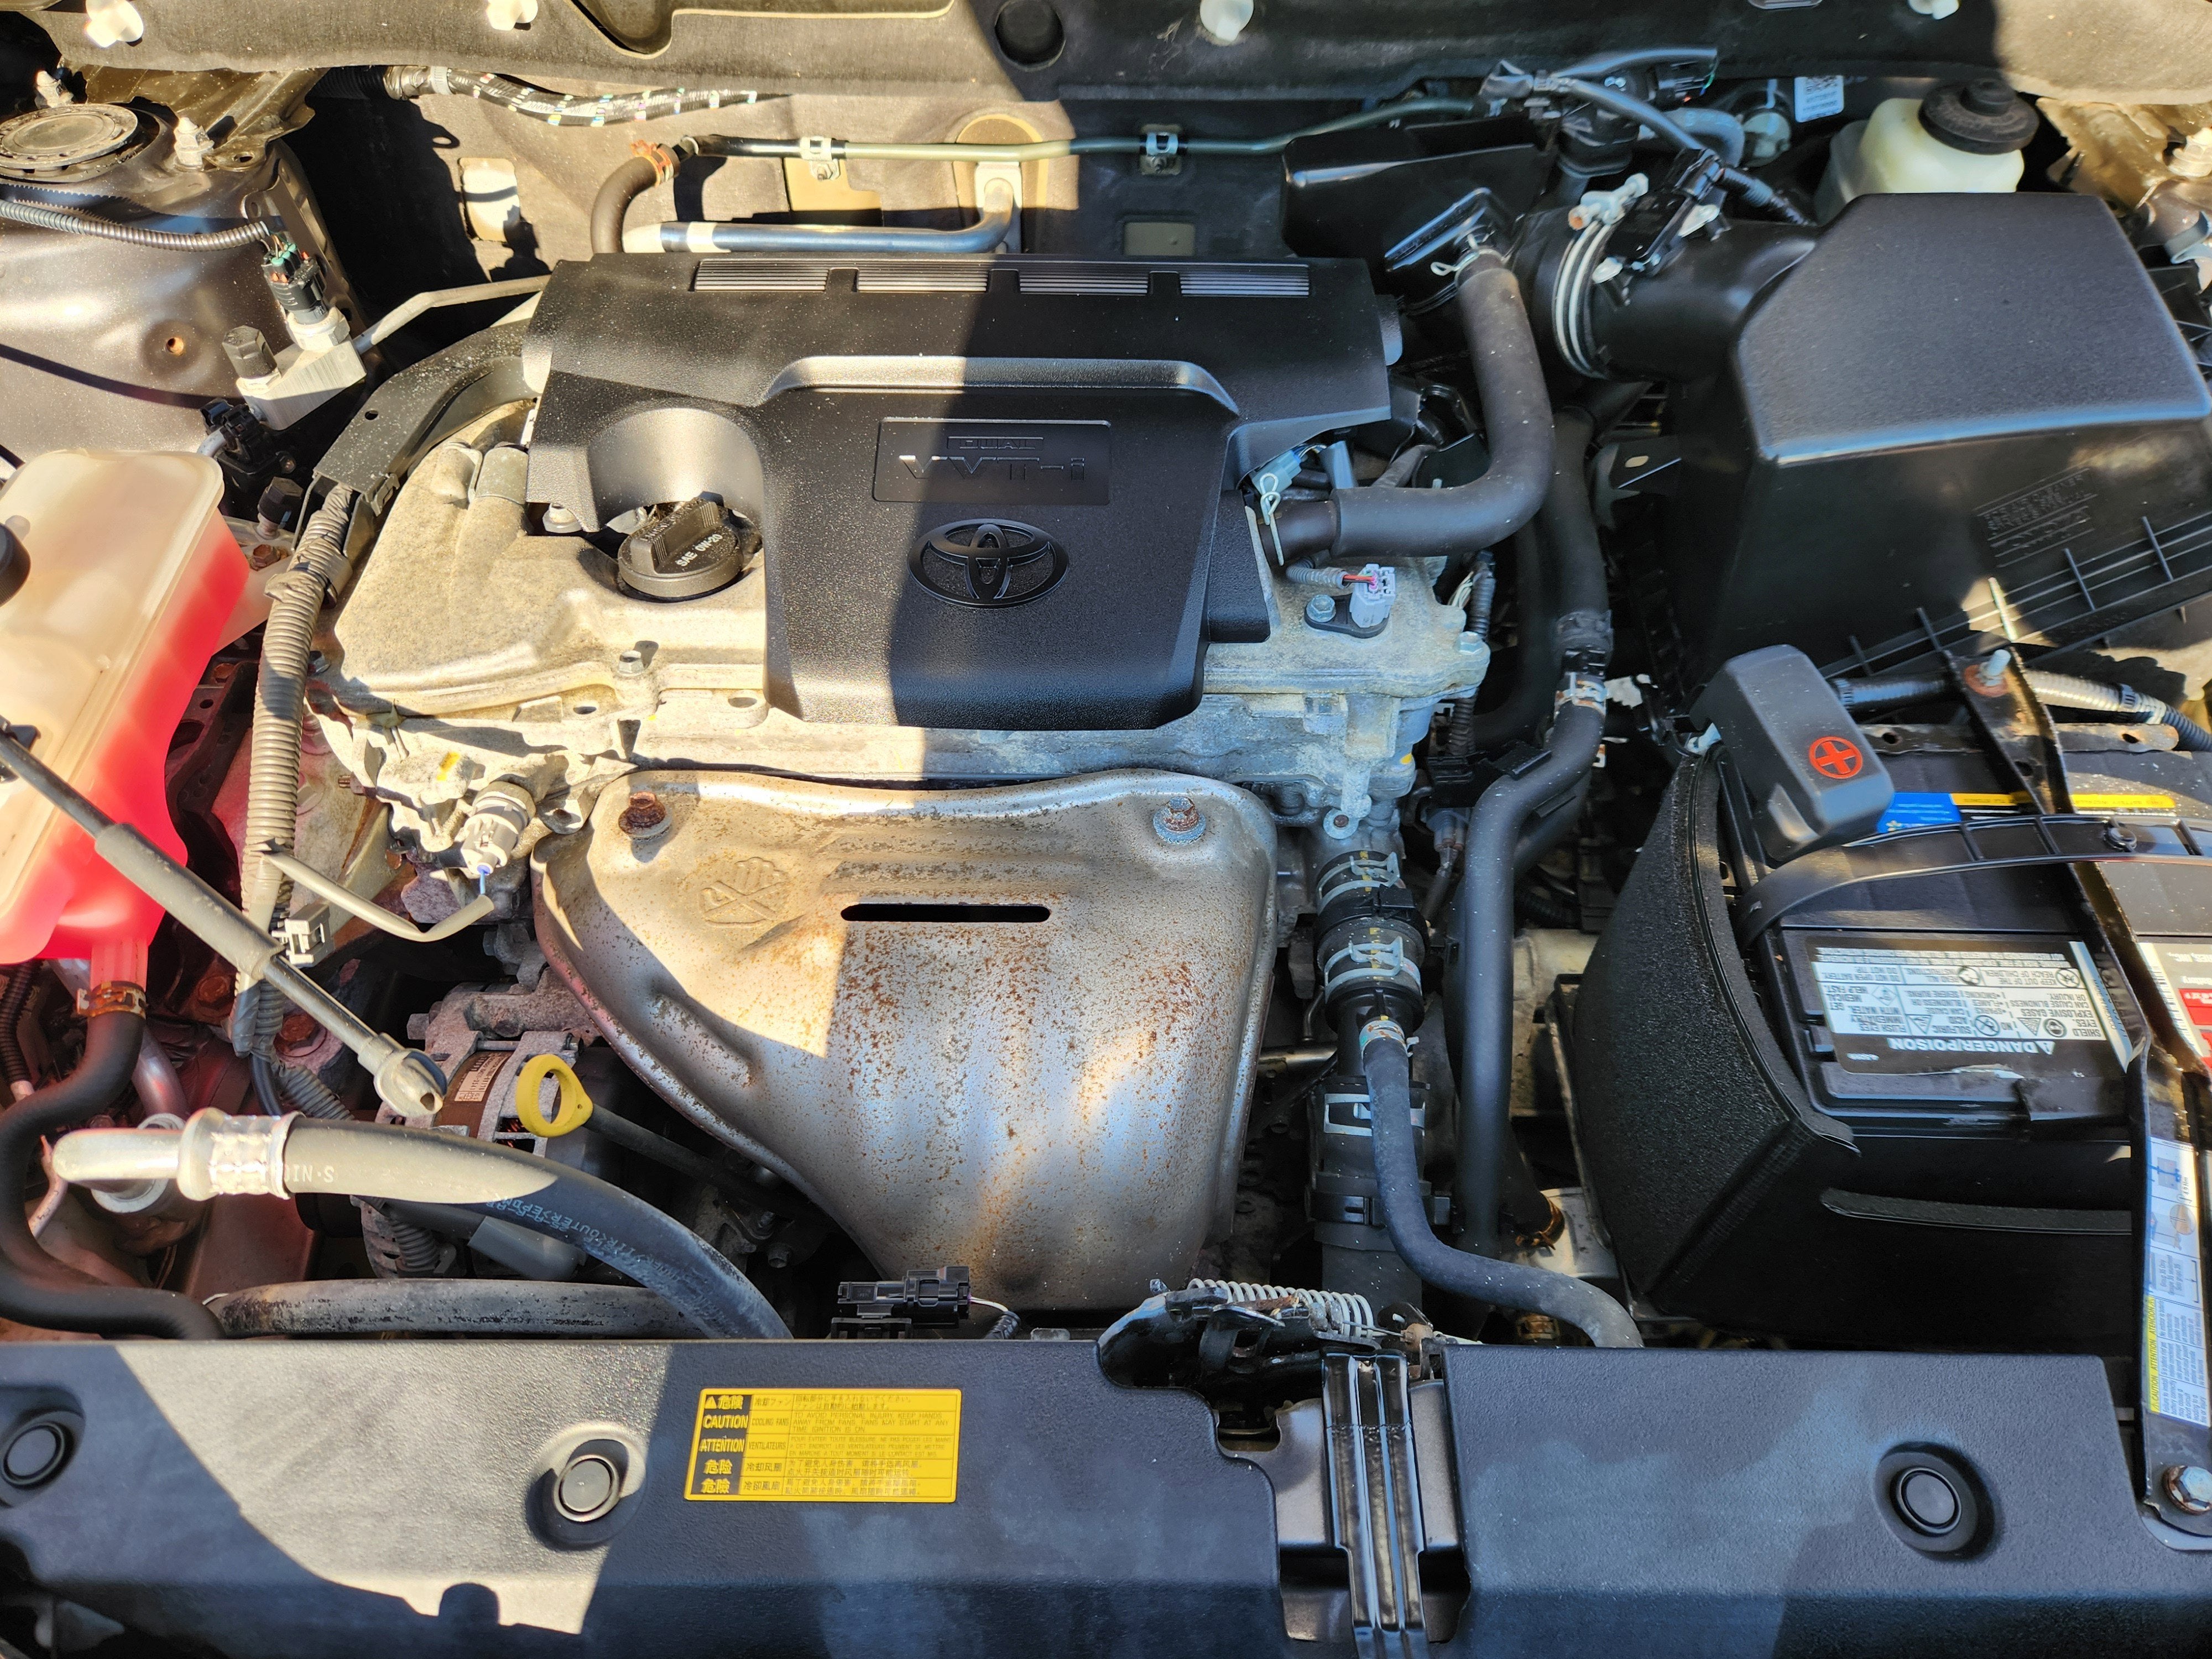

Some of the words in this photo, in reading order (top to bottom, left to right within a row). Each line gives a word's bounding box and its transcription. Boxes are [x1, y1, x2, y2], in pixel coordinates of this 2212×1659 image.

[674, 549, 698, 567] SAE
[693, 532, 723, 552] 0W-20
[1823, 985, 1845, 993] FAST.
[1825, 993, 1862, 1002] MEDICAL
[1829, 1002, 1844, 1010] GET
[1910, 998, 1921, 1006] OR
[1923, 999, 1961, 1007] BLINDNESS
[1879, 1006, 1902, 1015] WITH
[1926, 1006, 1948, 1015] CAUSE
[1950, 1007, 1964, 1015] CAN
[2048, 1009, 2093, 1017] EXPLOSIVE
[1948, 1016, 1967, 1025] ACID
[2072, 1019, 2096, 1027] EYES.
[1859, 1023, 1880, 1031] EYES
[1882, 1024, 1906, 1032] FLUSH
[1931, 1025, 1972, 1035] SULFURIC
[2000, 1022, 2012, 1030] NO
[2072, 1028, 2100, 1036] SHIELD
[1886, 1037, 2039, 1054] DANGER/POISON
[703, 1415, 748, 1428] CAUTION
[698, 1439, 744, 1452] ATTENTION
[703, 1459, 732, 1474] 危险
